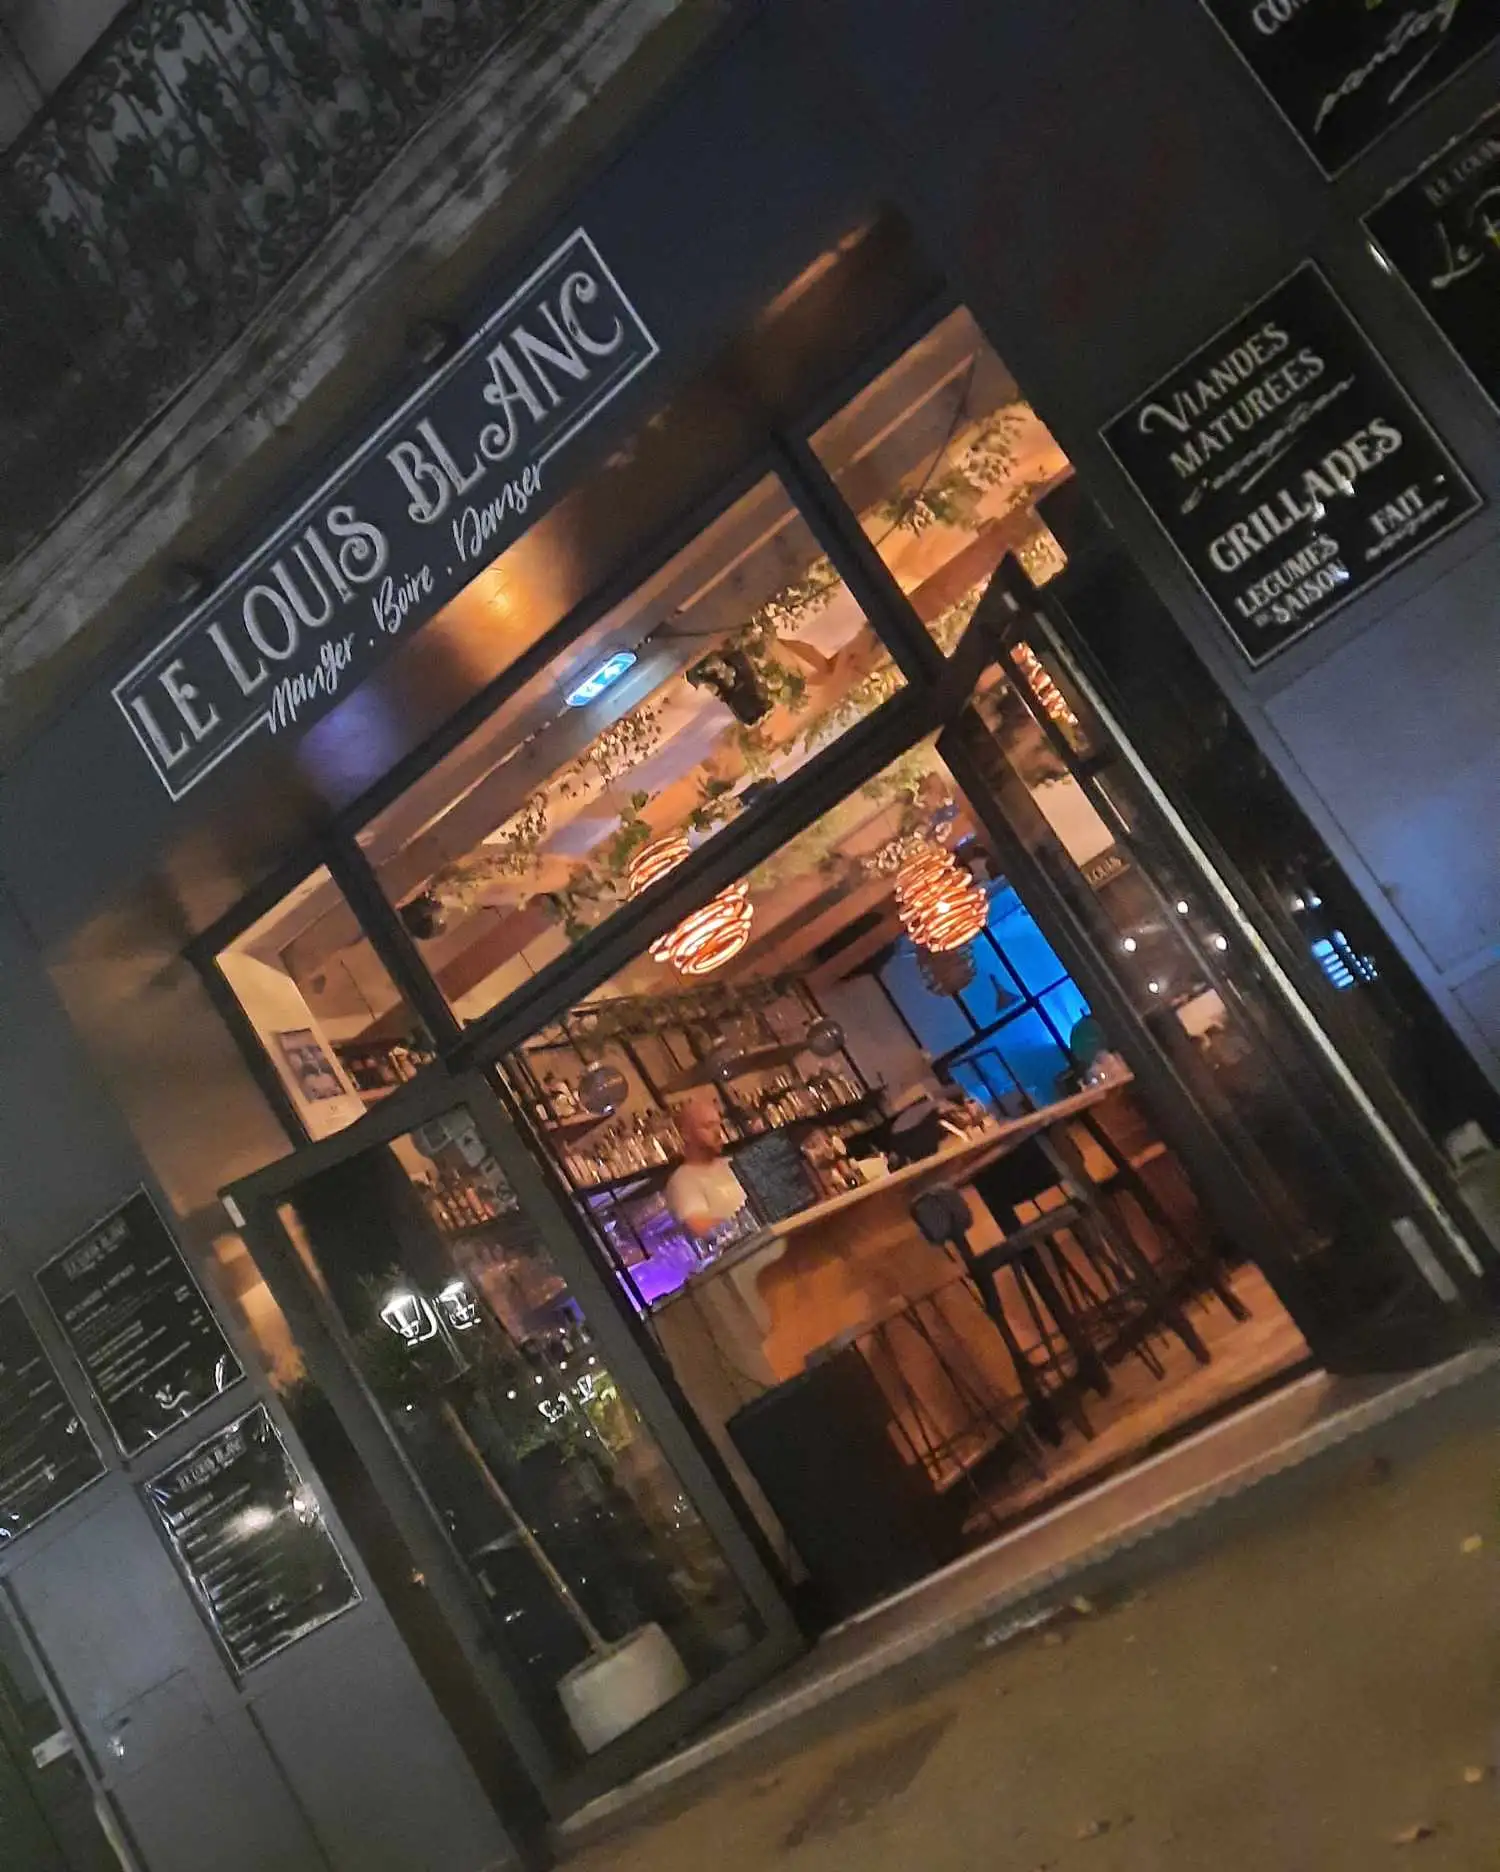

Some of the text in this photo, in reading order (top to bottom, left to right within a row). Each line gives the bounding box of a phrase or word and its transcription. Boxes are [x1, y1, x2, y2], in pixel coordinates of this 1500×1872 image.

[131, 271, 624, 770] LE LOUIS BLANC
[266, 463, 546, 735] Manger Boire Danser
[1208, 417, 1403, 573] GRILLADES
[1369, 484, 1424, 536] FAIT
